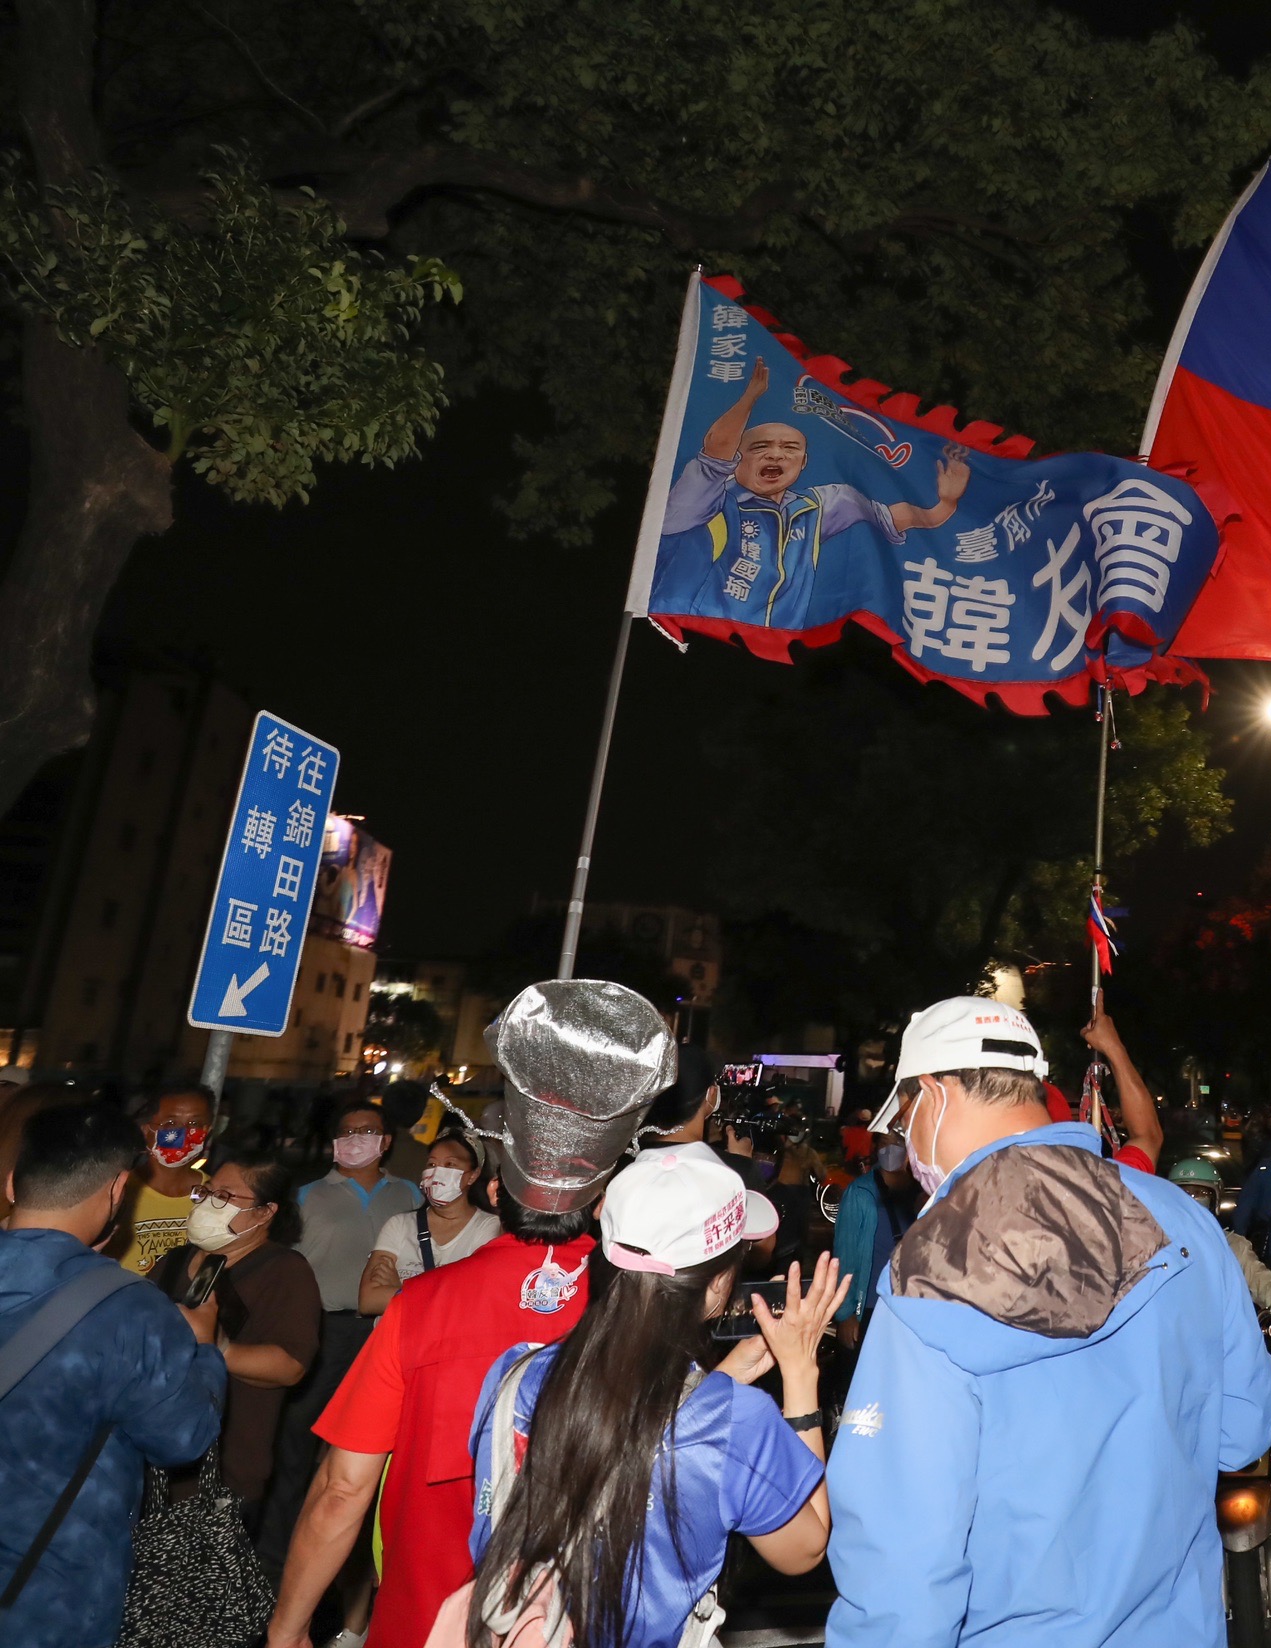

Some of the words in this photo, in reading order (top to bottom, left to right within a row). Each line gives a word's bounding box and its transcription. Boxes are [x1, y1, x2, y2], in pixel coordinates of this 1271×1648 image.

[707, 304, 749, 383] 韓家軍
[723, 539, 762, 602] 韓國瑜
[902, 478, 1193, 673] 韓友會
[221, 728, 294, 949] 待轉區
[258, 746, 327, 958] 往錦田路
